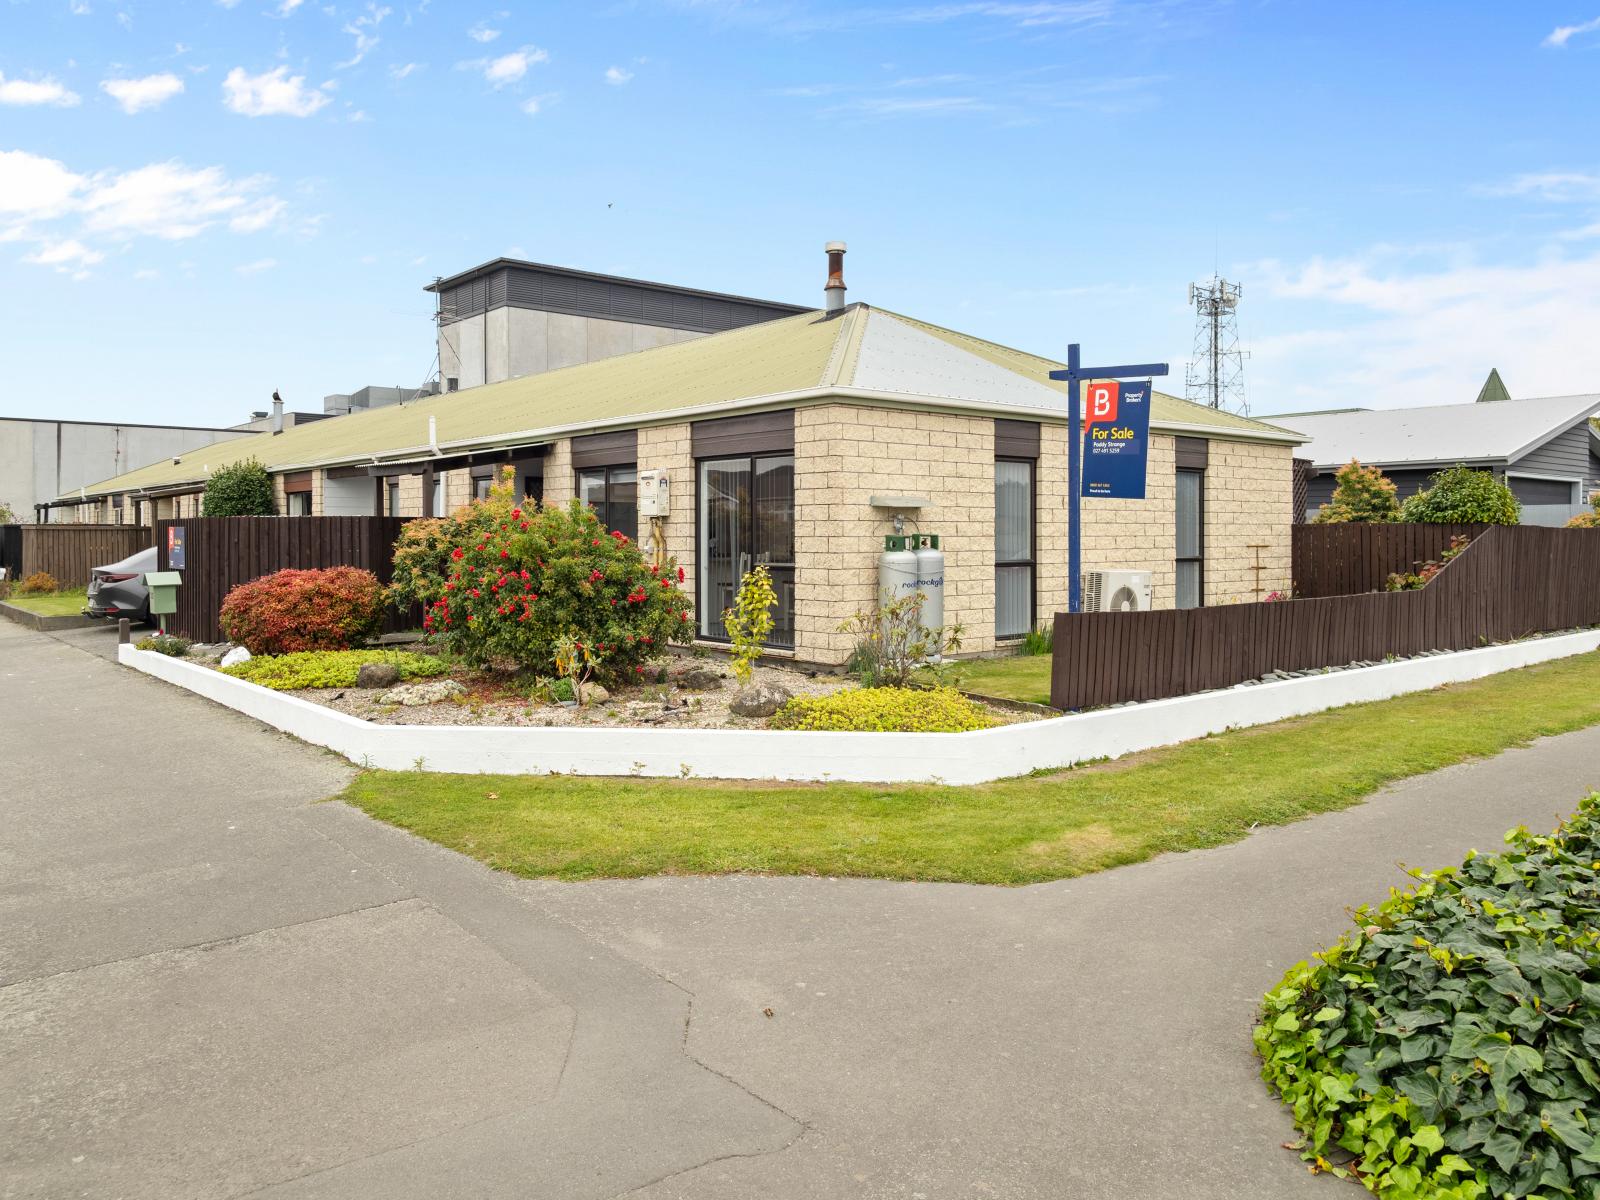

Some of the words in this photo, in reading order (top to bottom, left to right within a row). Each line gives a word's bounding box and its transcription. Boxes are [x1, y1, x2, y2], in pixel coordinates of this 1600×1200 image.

[1094, 389, 1110, 416] B
[1092, 427, 1108, 440] For
[1111, 427, 1134, 439] Sale
